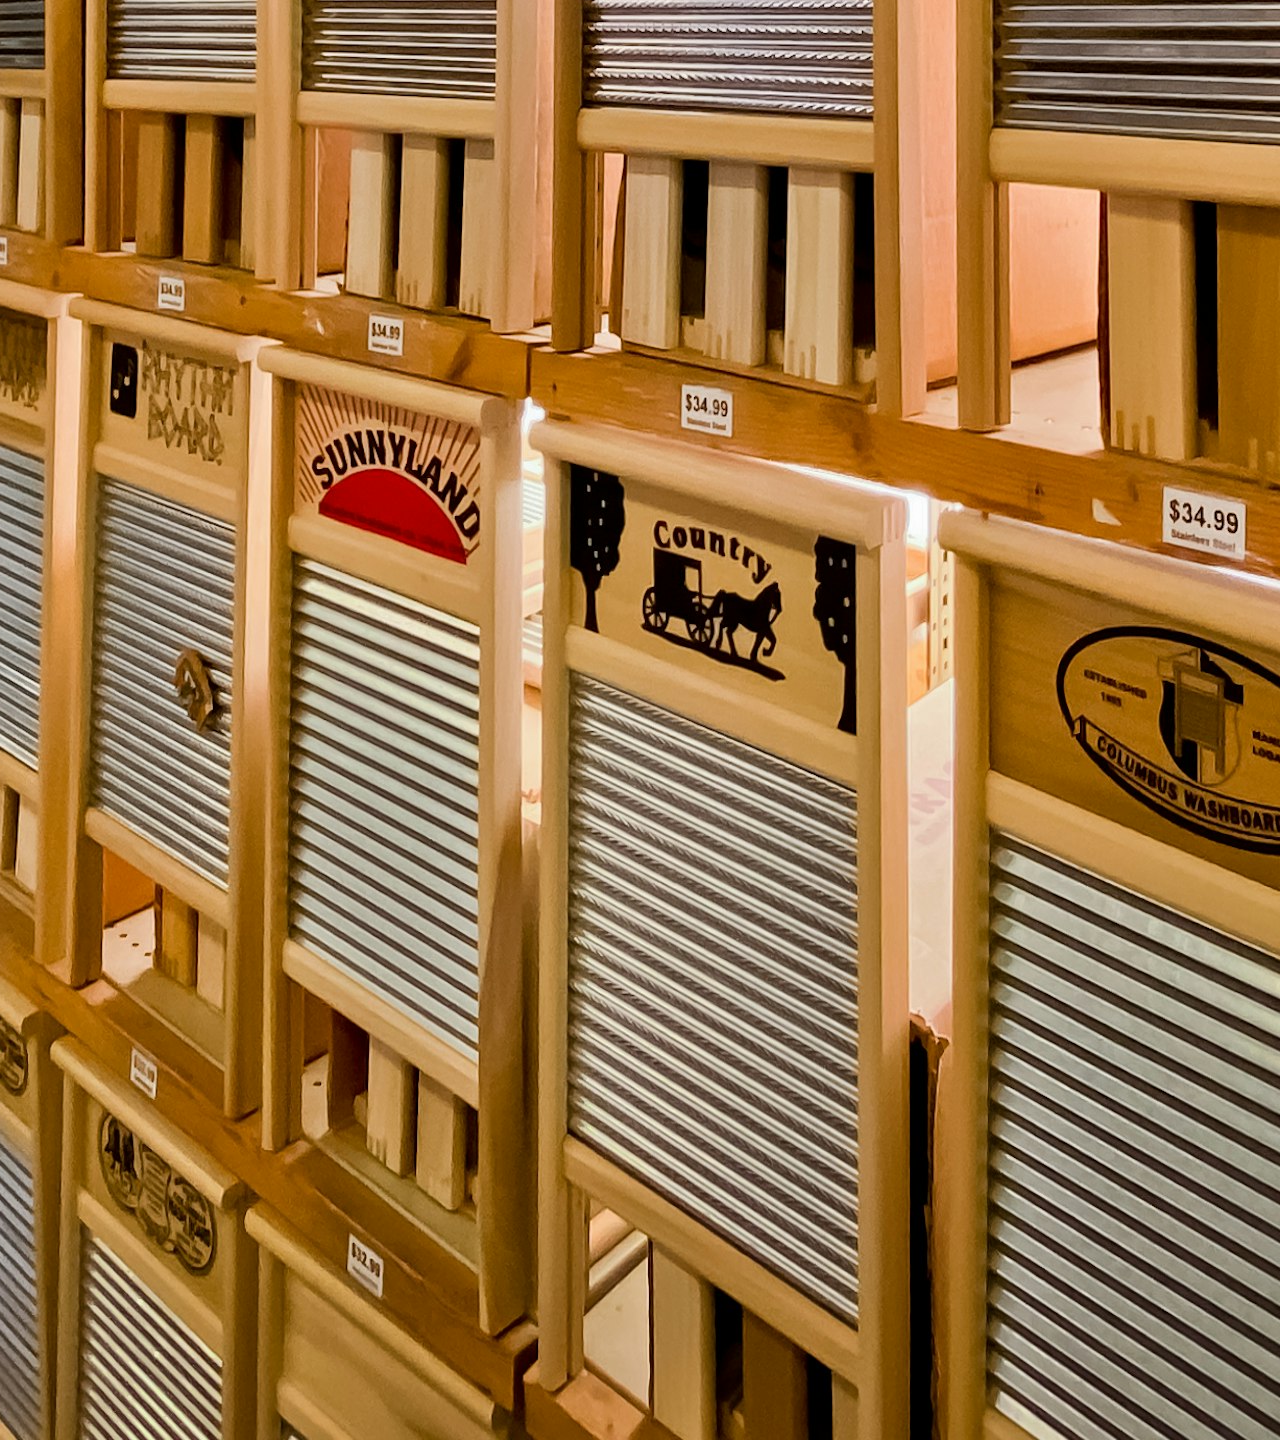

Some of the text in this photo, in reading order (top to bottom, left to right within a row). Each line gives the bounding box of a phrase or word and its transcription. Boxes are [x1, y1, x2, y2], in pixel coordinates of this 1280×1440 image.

[685, 393, 728, 417] $34.99
[312, 429, 481, 540] SUNNYLAND
[1169, 499, 1239, 534] $34.99
[654, 520, 772, 585] Country
[1096, 735, 1178, 800] COLUMBUS
